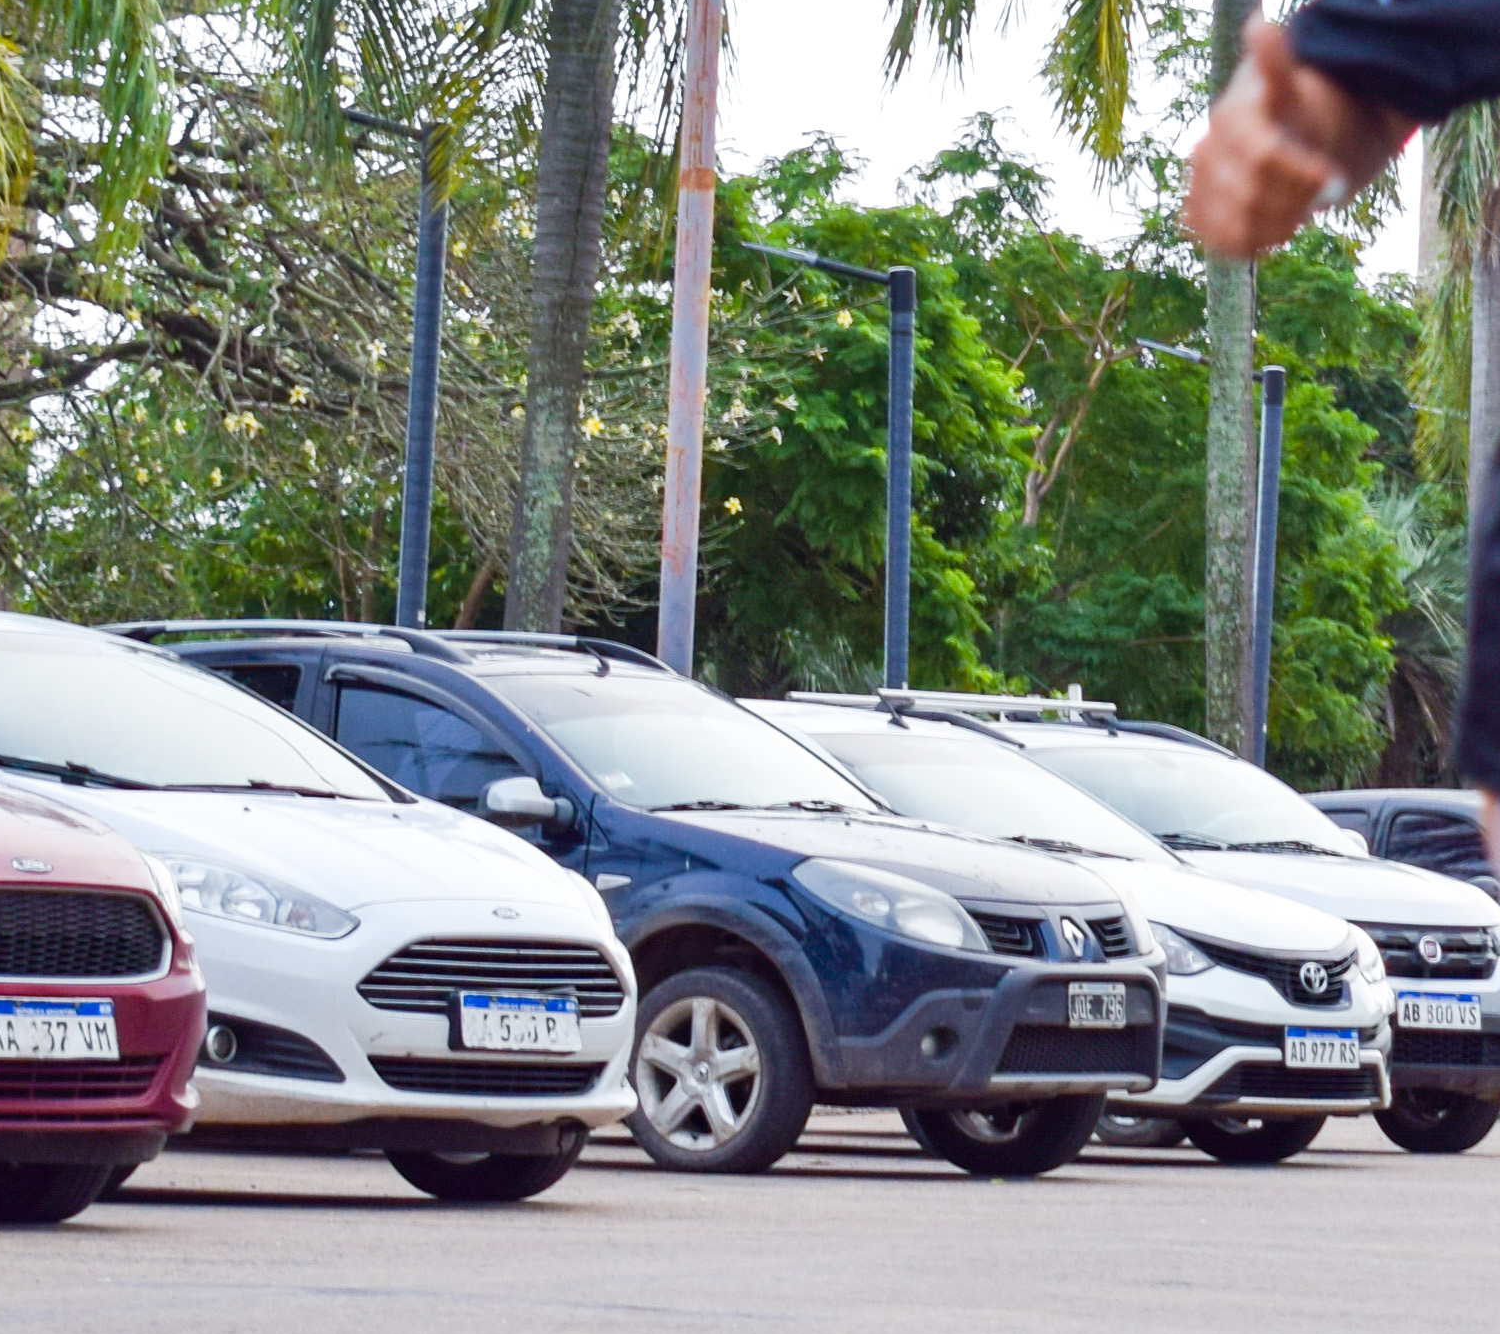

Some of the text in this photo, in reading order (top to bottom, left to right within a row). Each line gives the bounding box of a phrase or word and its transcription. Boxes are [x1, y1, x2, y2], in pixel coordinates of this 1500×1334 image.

[1101, 995, 1124, 1021] 796
[1403, 1003, 1420, 1022] AB
[1459, 1006, 1477, 1025] VS
[77, 1021, 112, 1052] VM
[1291, 1042, 1356, 1064] AD 977 RS
